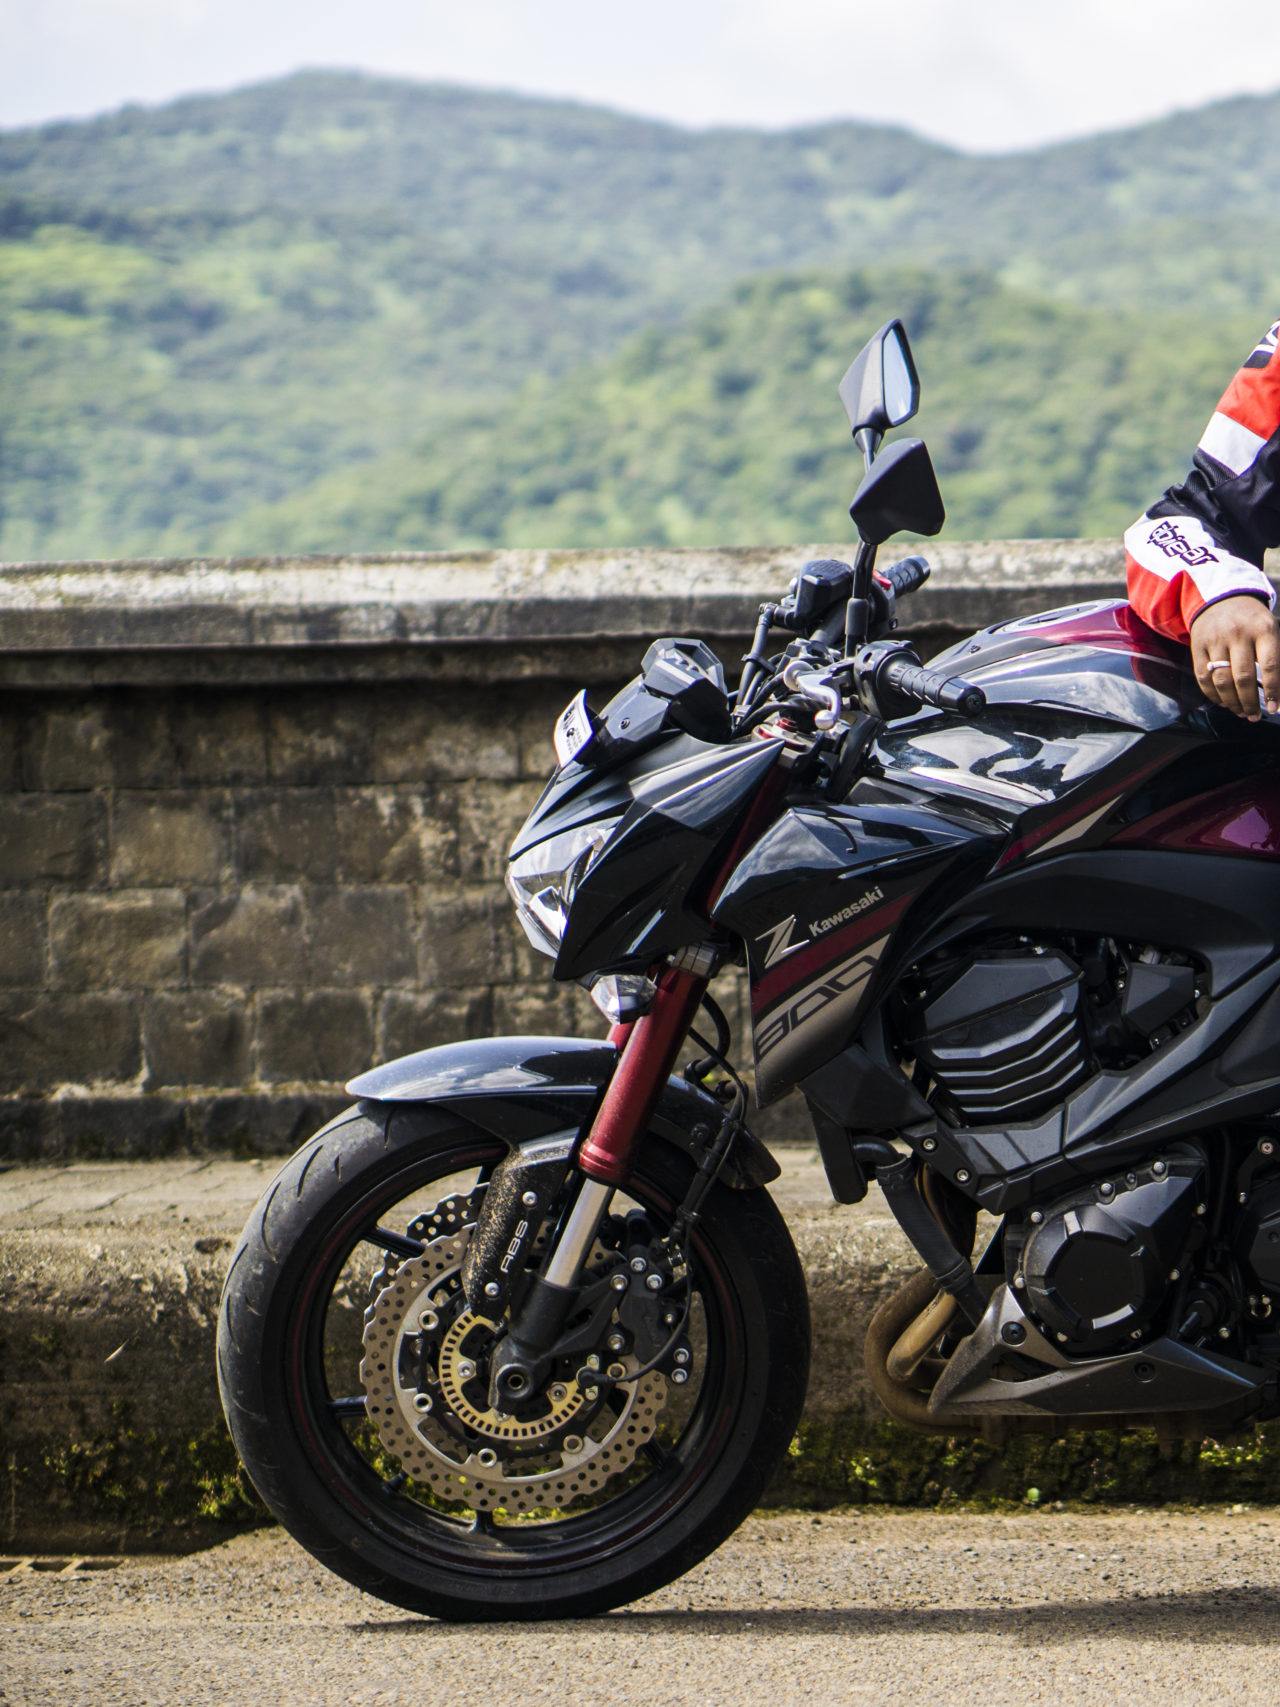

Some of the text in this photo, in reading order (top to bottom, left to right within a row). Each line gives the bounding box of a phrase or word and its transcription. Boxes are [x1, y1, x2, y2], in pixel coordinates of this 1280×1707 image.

[754, 885, 885, 970] Z Kawasaki
[754, 955, 879, 1065] 800
[500, 1220, 528, 1273] ABS
